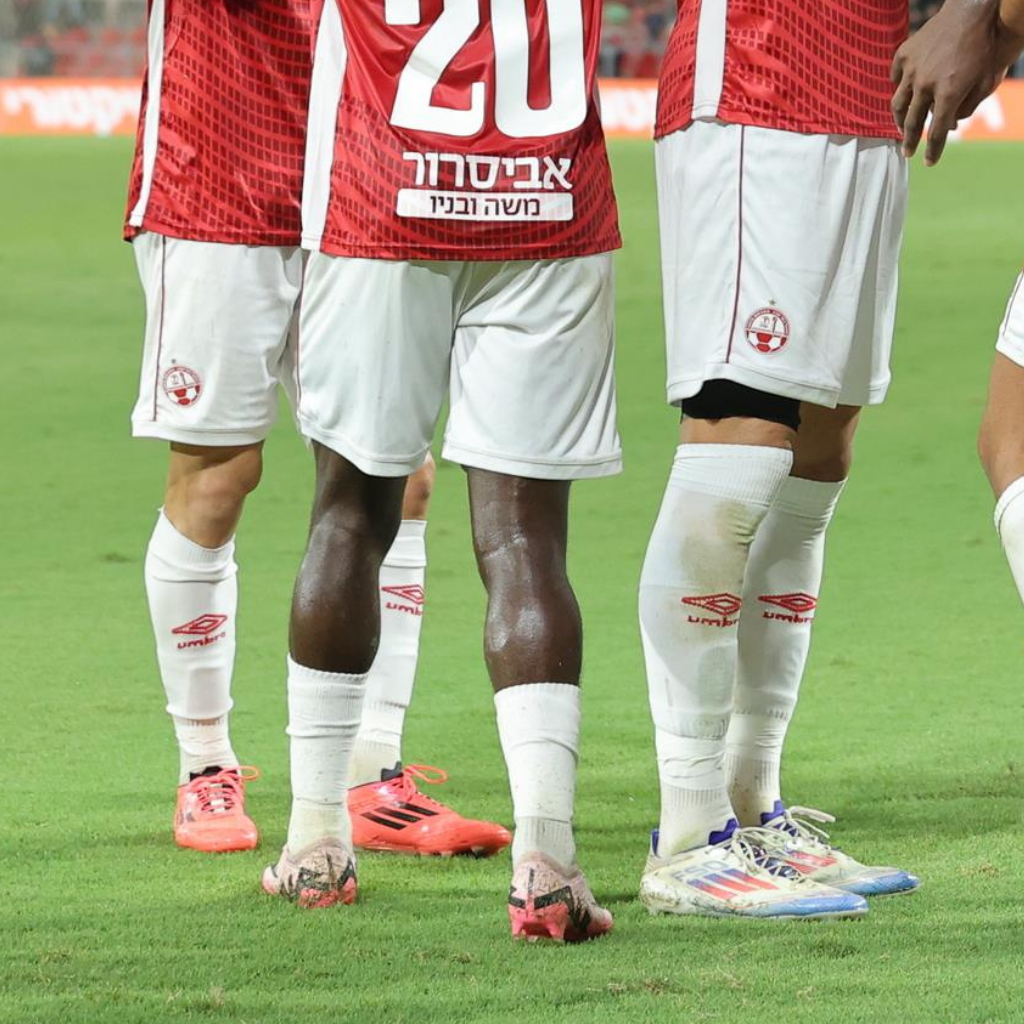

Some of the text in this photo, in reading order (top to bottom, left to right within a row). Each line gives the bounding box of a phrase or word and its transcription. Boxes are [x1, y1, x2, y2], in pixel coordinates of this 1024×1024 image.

[402, 151, 573, 190] אביסרור
[430, 195, 541, 216] משה ובניו
[687, 614, 739, 628] umbr
[762, 609, 814, 624] umbr
